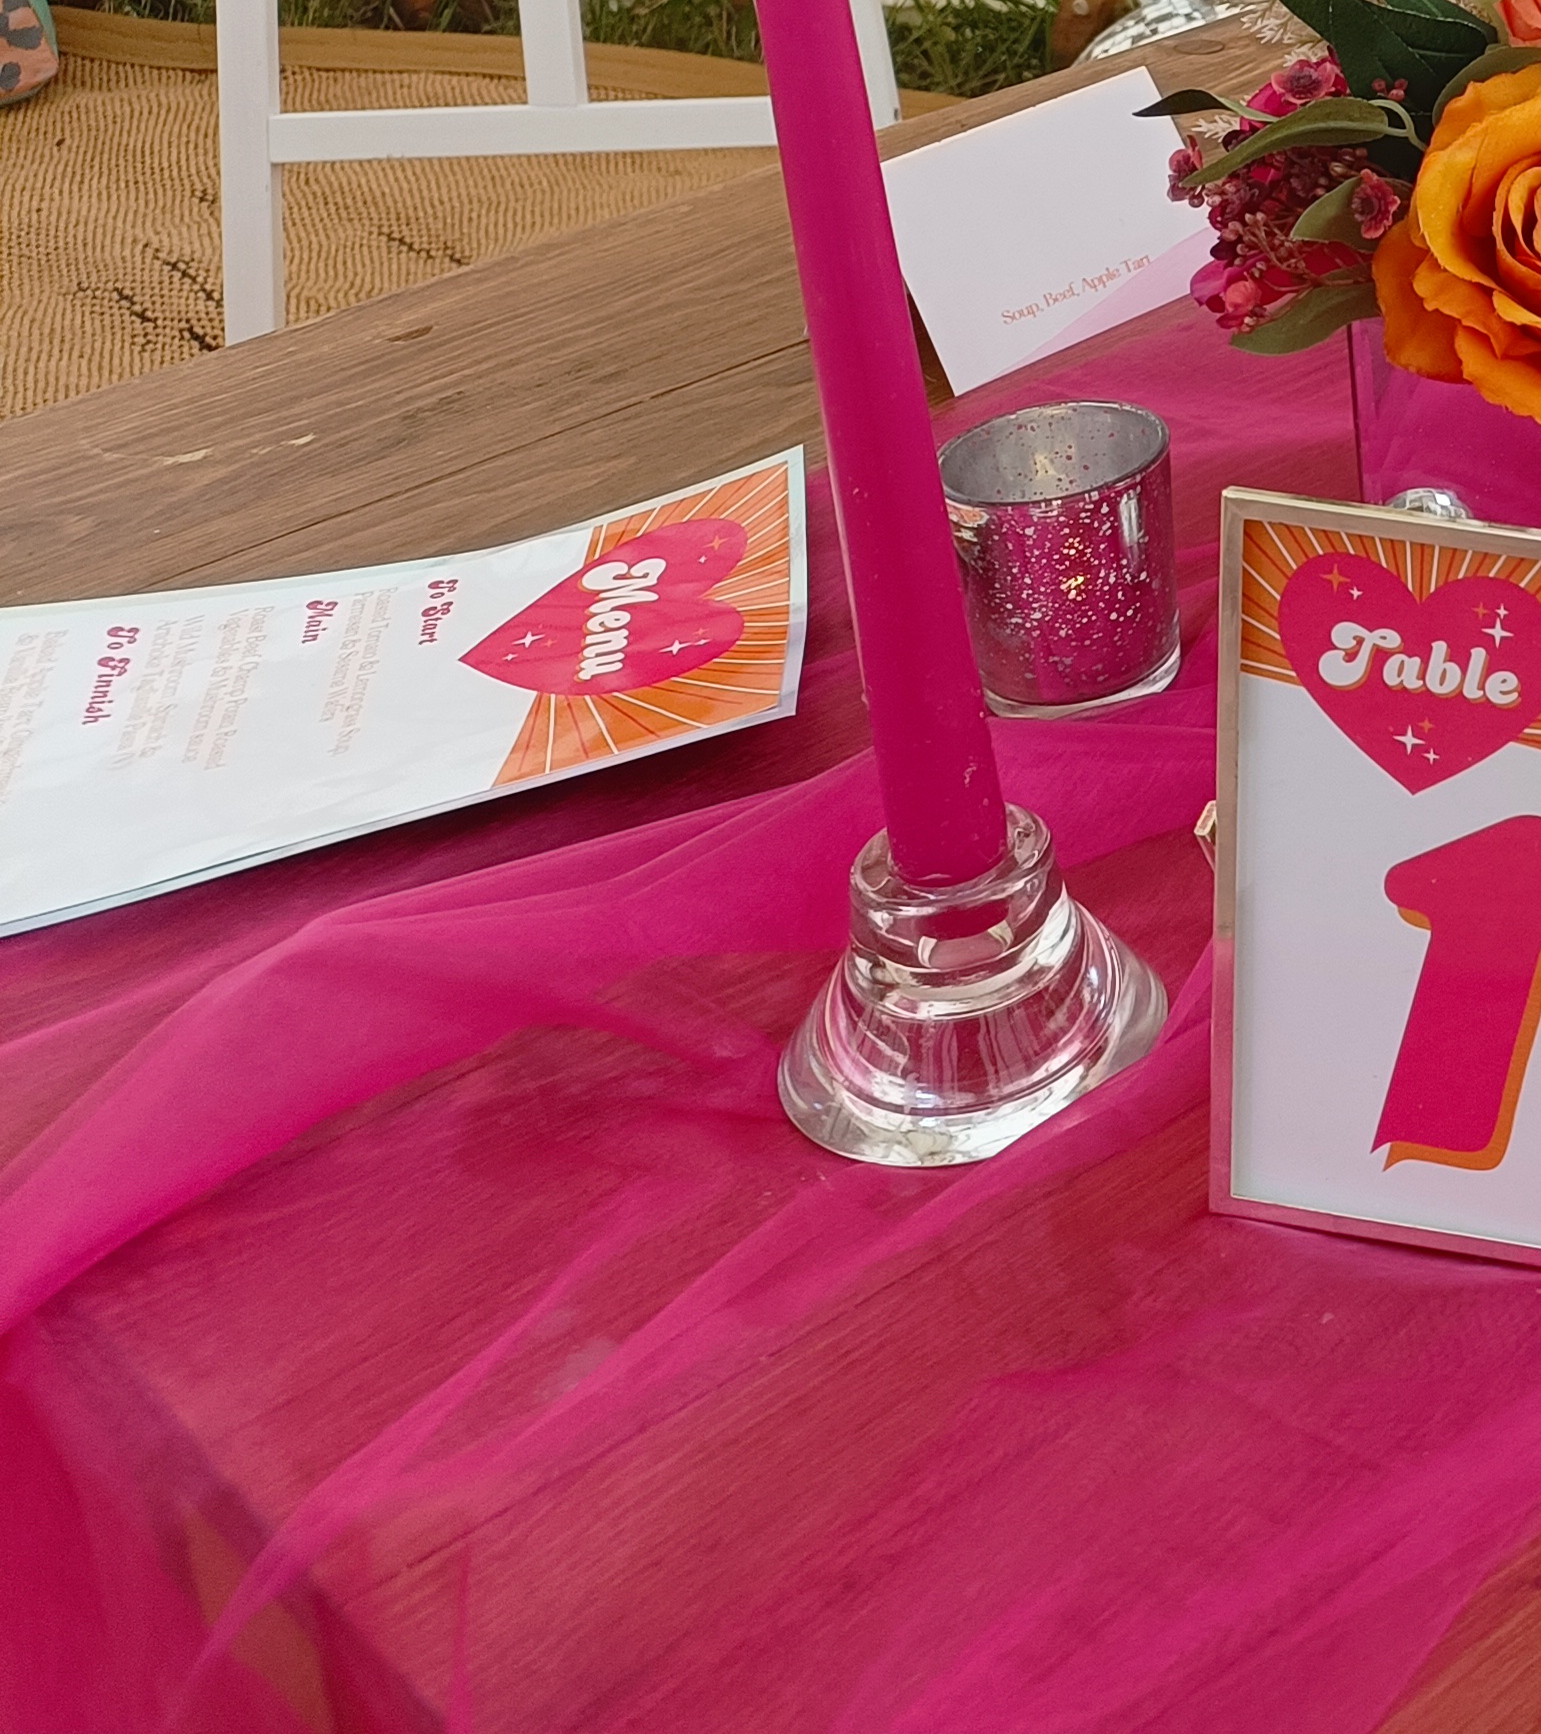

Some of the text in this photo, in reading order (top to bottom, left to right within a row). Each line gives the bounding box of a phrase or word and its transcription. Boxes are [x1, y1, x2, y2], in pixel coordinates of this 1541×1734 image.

[1001, 303, 1044, 324] Soup,
[1043, 282, 1080, 307] Beef,
[1082, 267, 1121, 292] Apple
[302, 600, 338, 644] Main
[418, 579, 459, 645] To Start
[577, 557, 666, 680] Menu
[82, 626, 141, 725] To Finnish
[1318, 621, 1522, 706] Table
